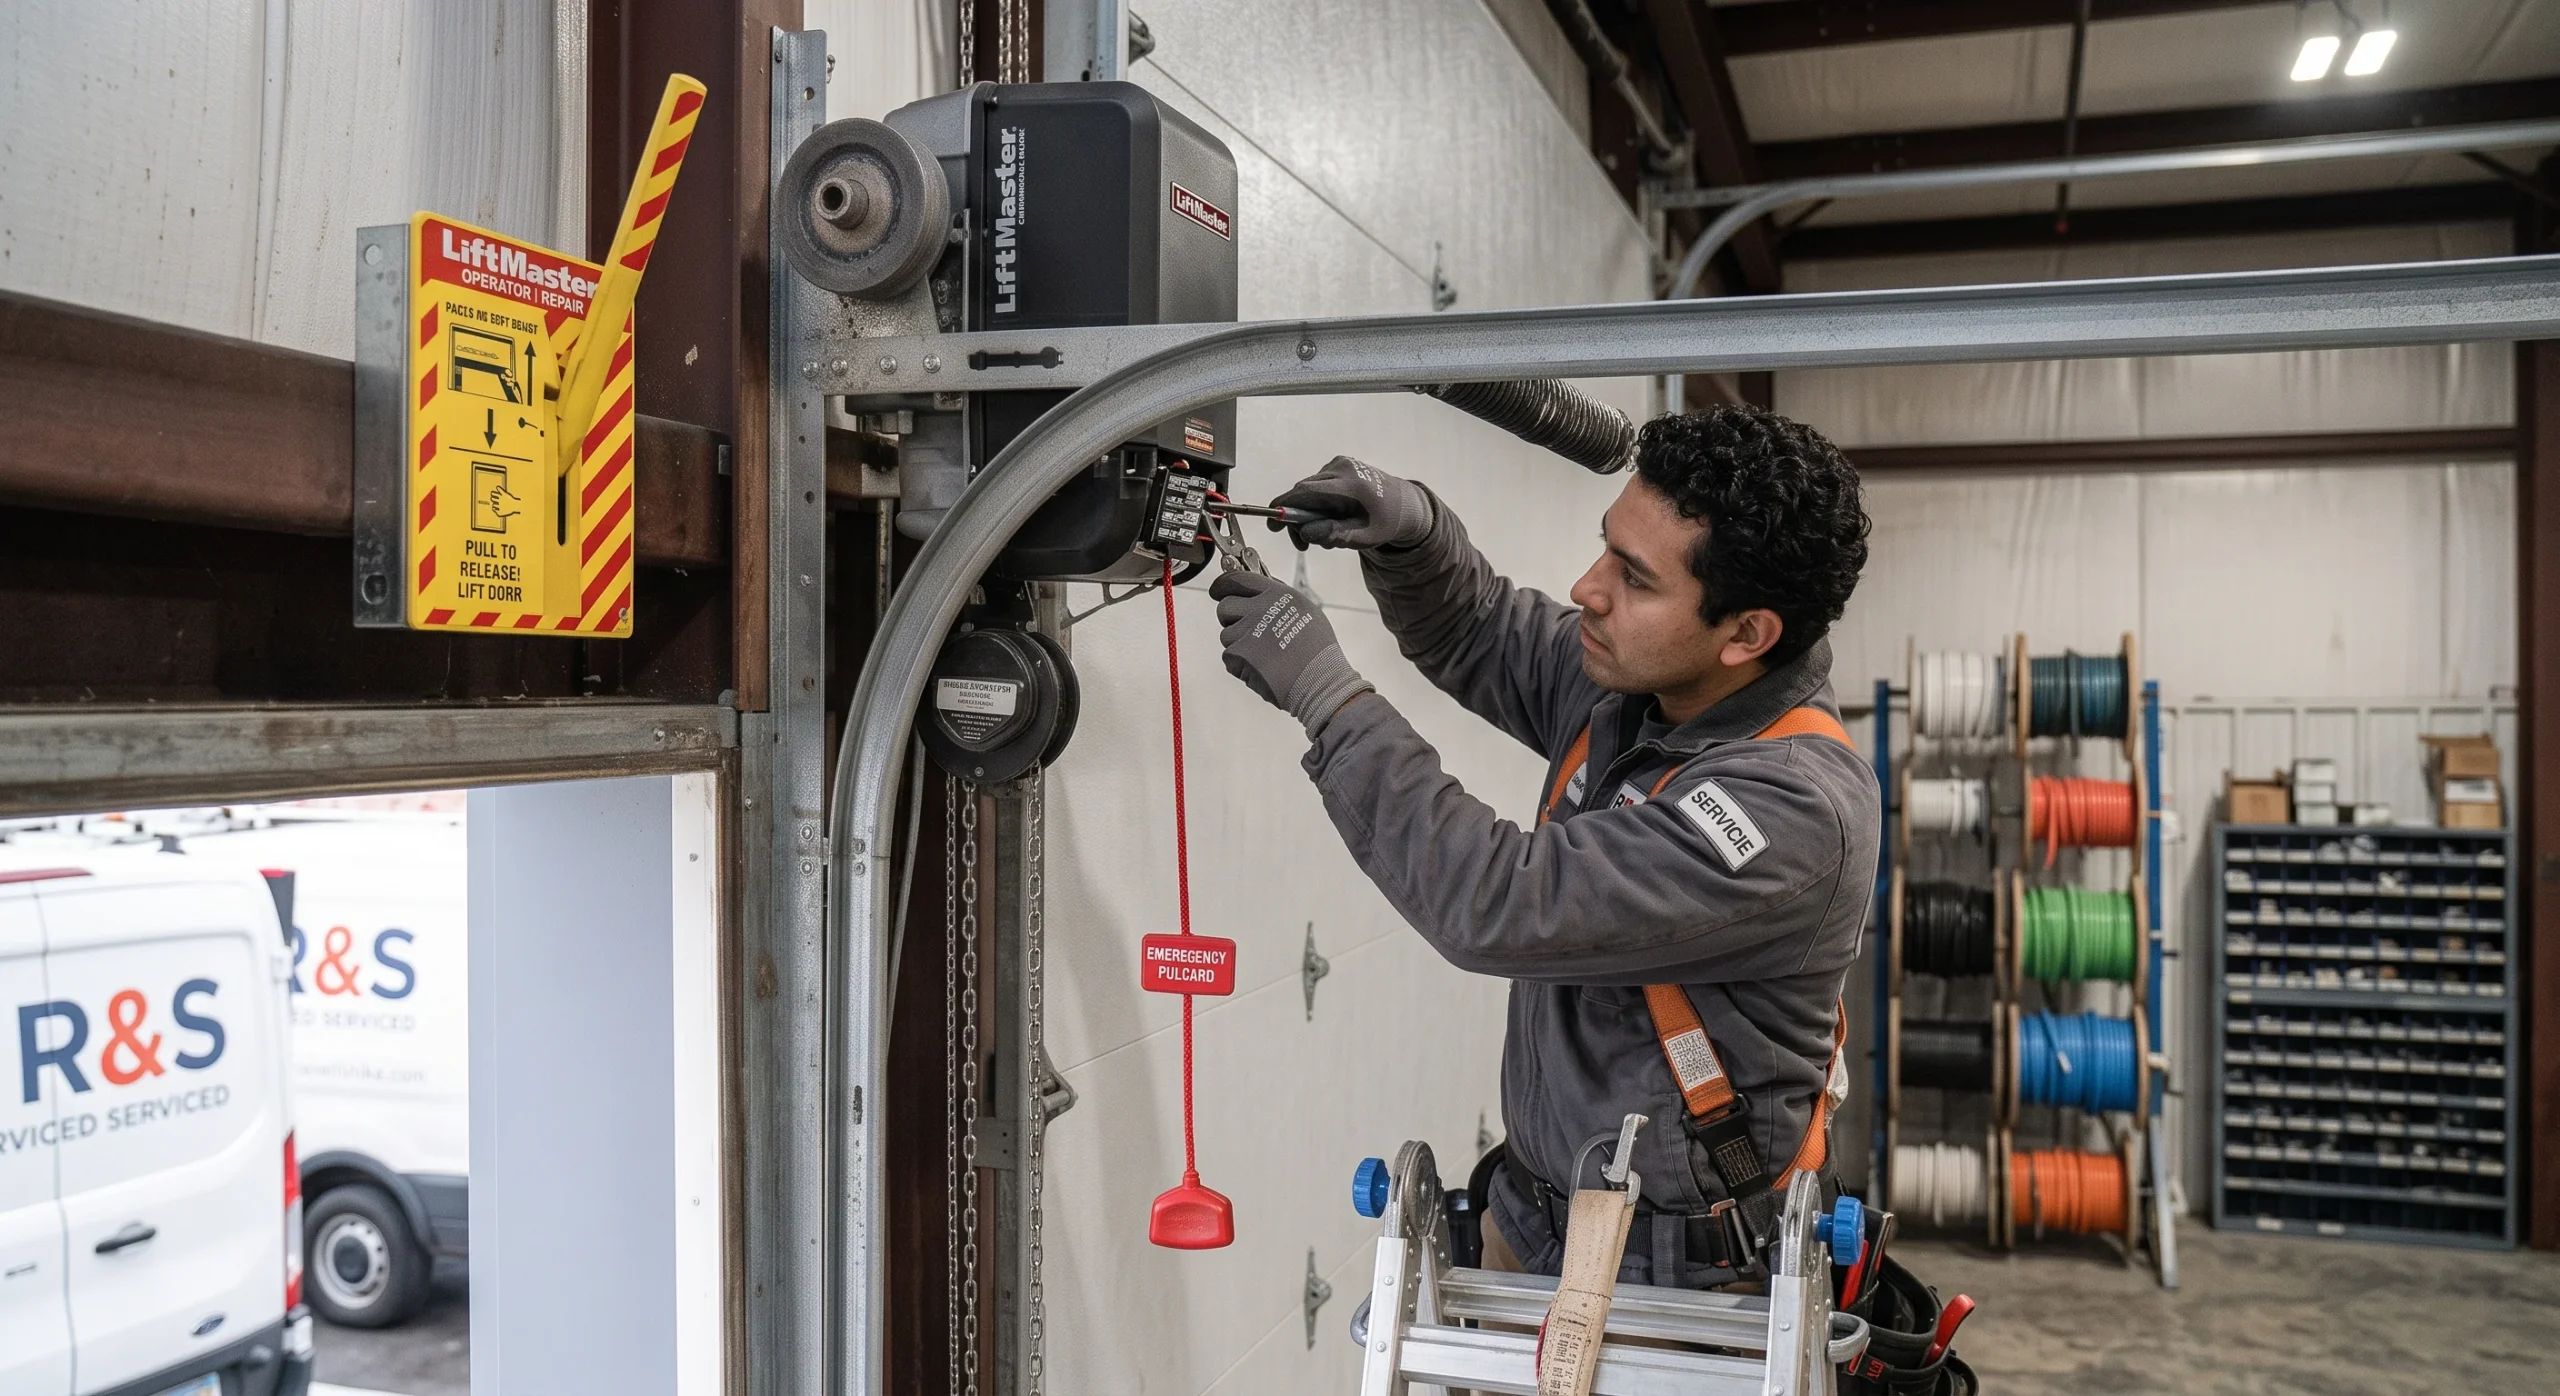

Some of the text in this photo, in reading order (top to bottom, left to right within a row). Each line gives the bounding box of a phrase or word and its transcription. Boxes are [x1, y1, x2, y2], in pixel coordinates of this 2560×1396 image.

[442, 228, 599, 299] LiftMaster
[461, 268, 532, 300] OPERATOR
[541, 290, 584, 315] REPAIR
[465, 539, 517, 560] PULL TO
[460, 561, 521, 582] RELEASE!
[458, 582, 522, 603] LIFT DORR
[1691, 790, 1755, 857] SERVICIE
[1146, 946, 1227, 965] EMEREGENCY
[1158, 965, 1215, 983] PULCARD
[17, 977, 226, 1104] R&S
[107, 1084, 230, 1132] SERVICED
